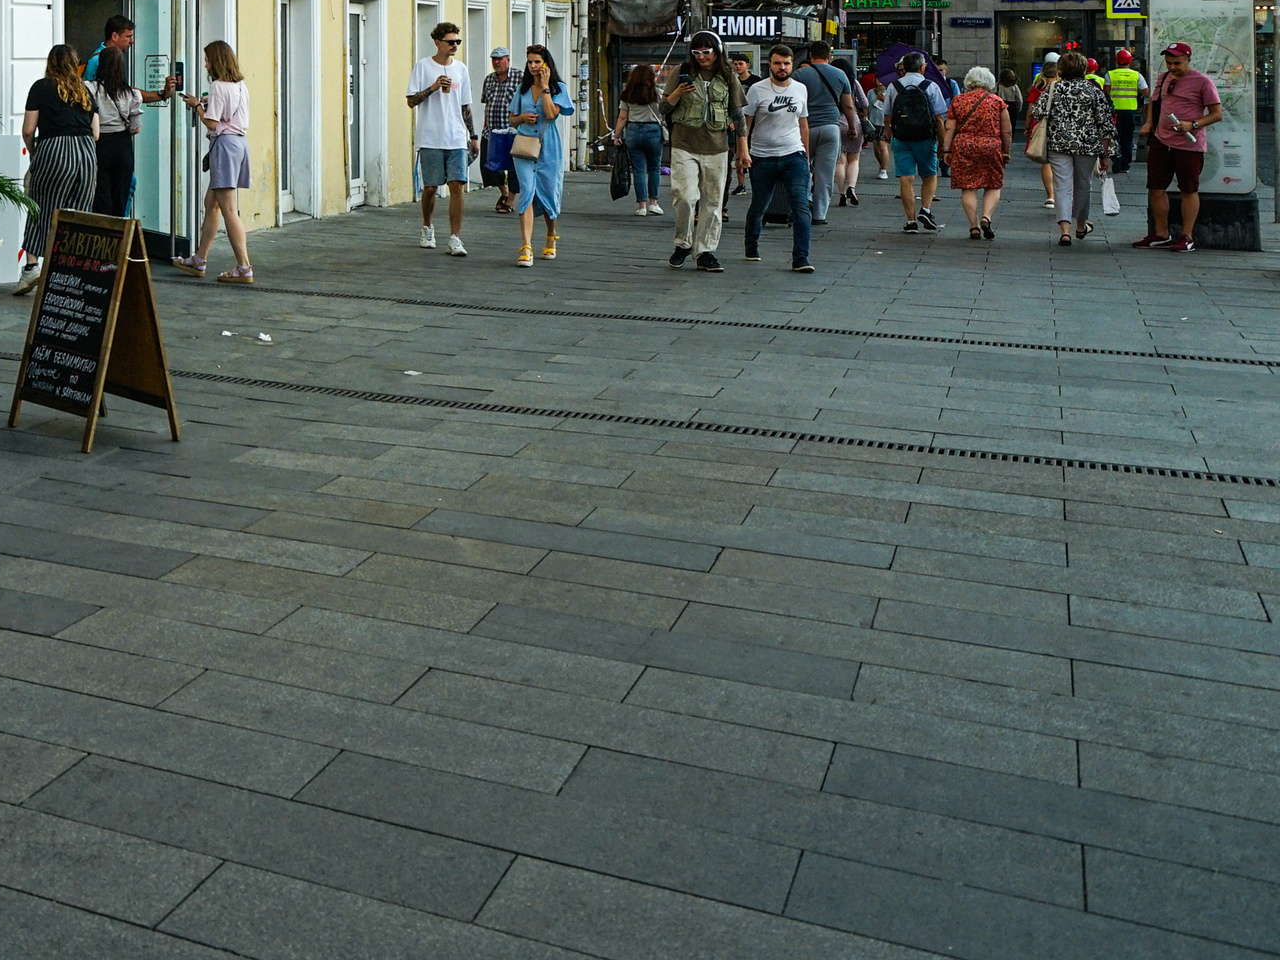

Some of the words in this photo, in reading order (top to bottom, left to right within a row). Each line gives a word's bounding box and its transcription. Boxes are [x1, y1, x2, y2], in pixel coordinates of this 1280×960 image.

[910, 0, 950, 8] МААЗИН
[708, 15, 778, 36] РЕМОНТ
[773, 95, 794, 105] NIKE
[786, 105, 798, 113] SB
